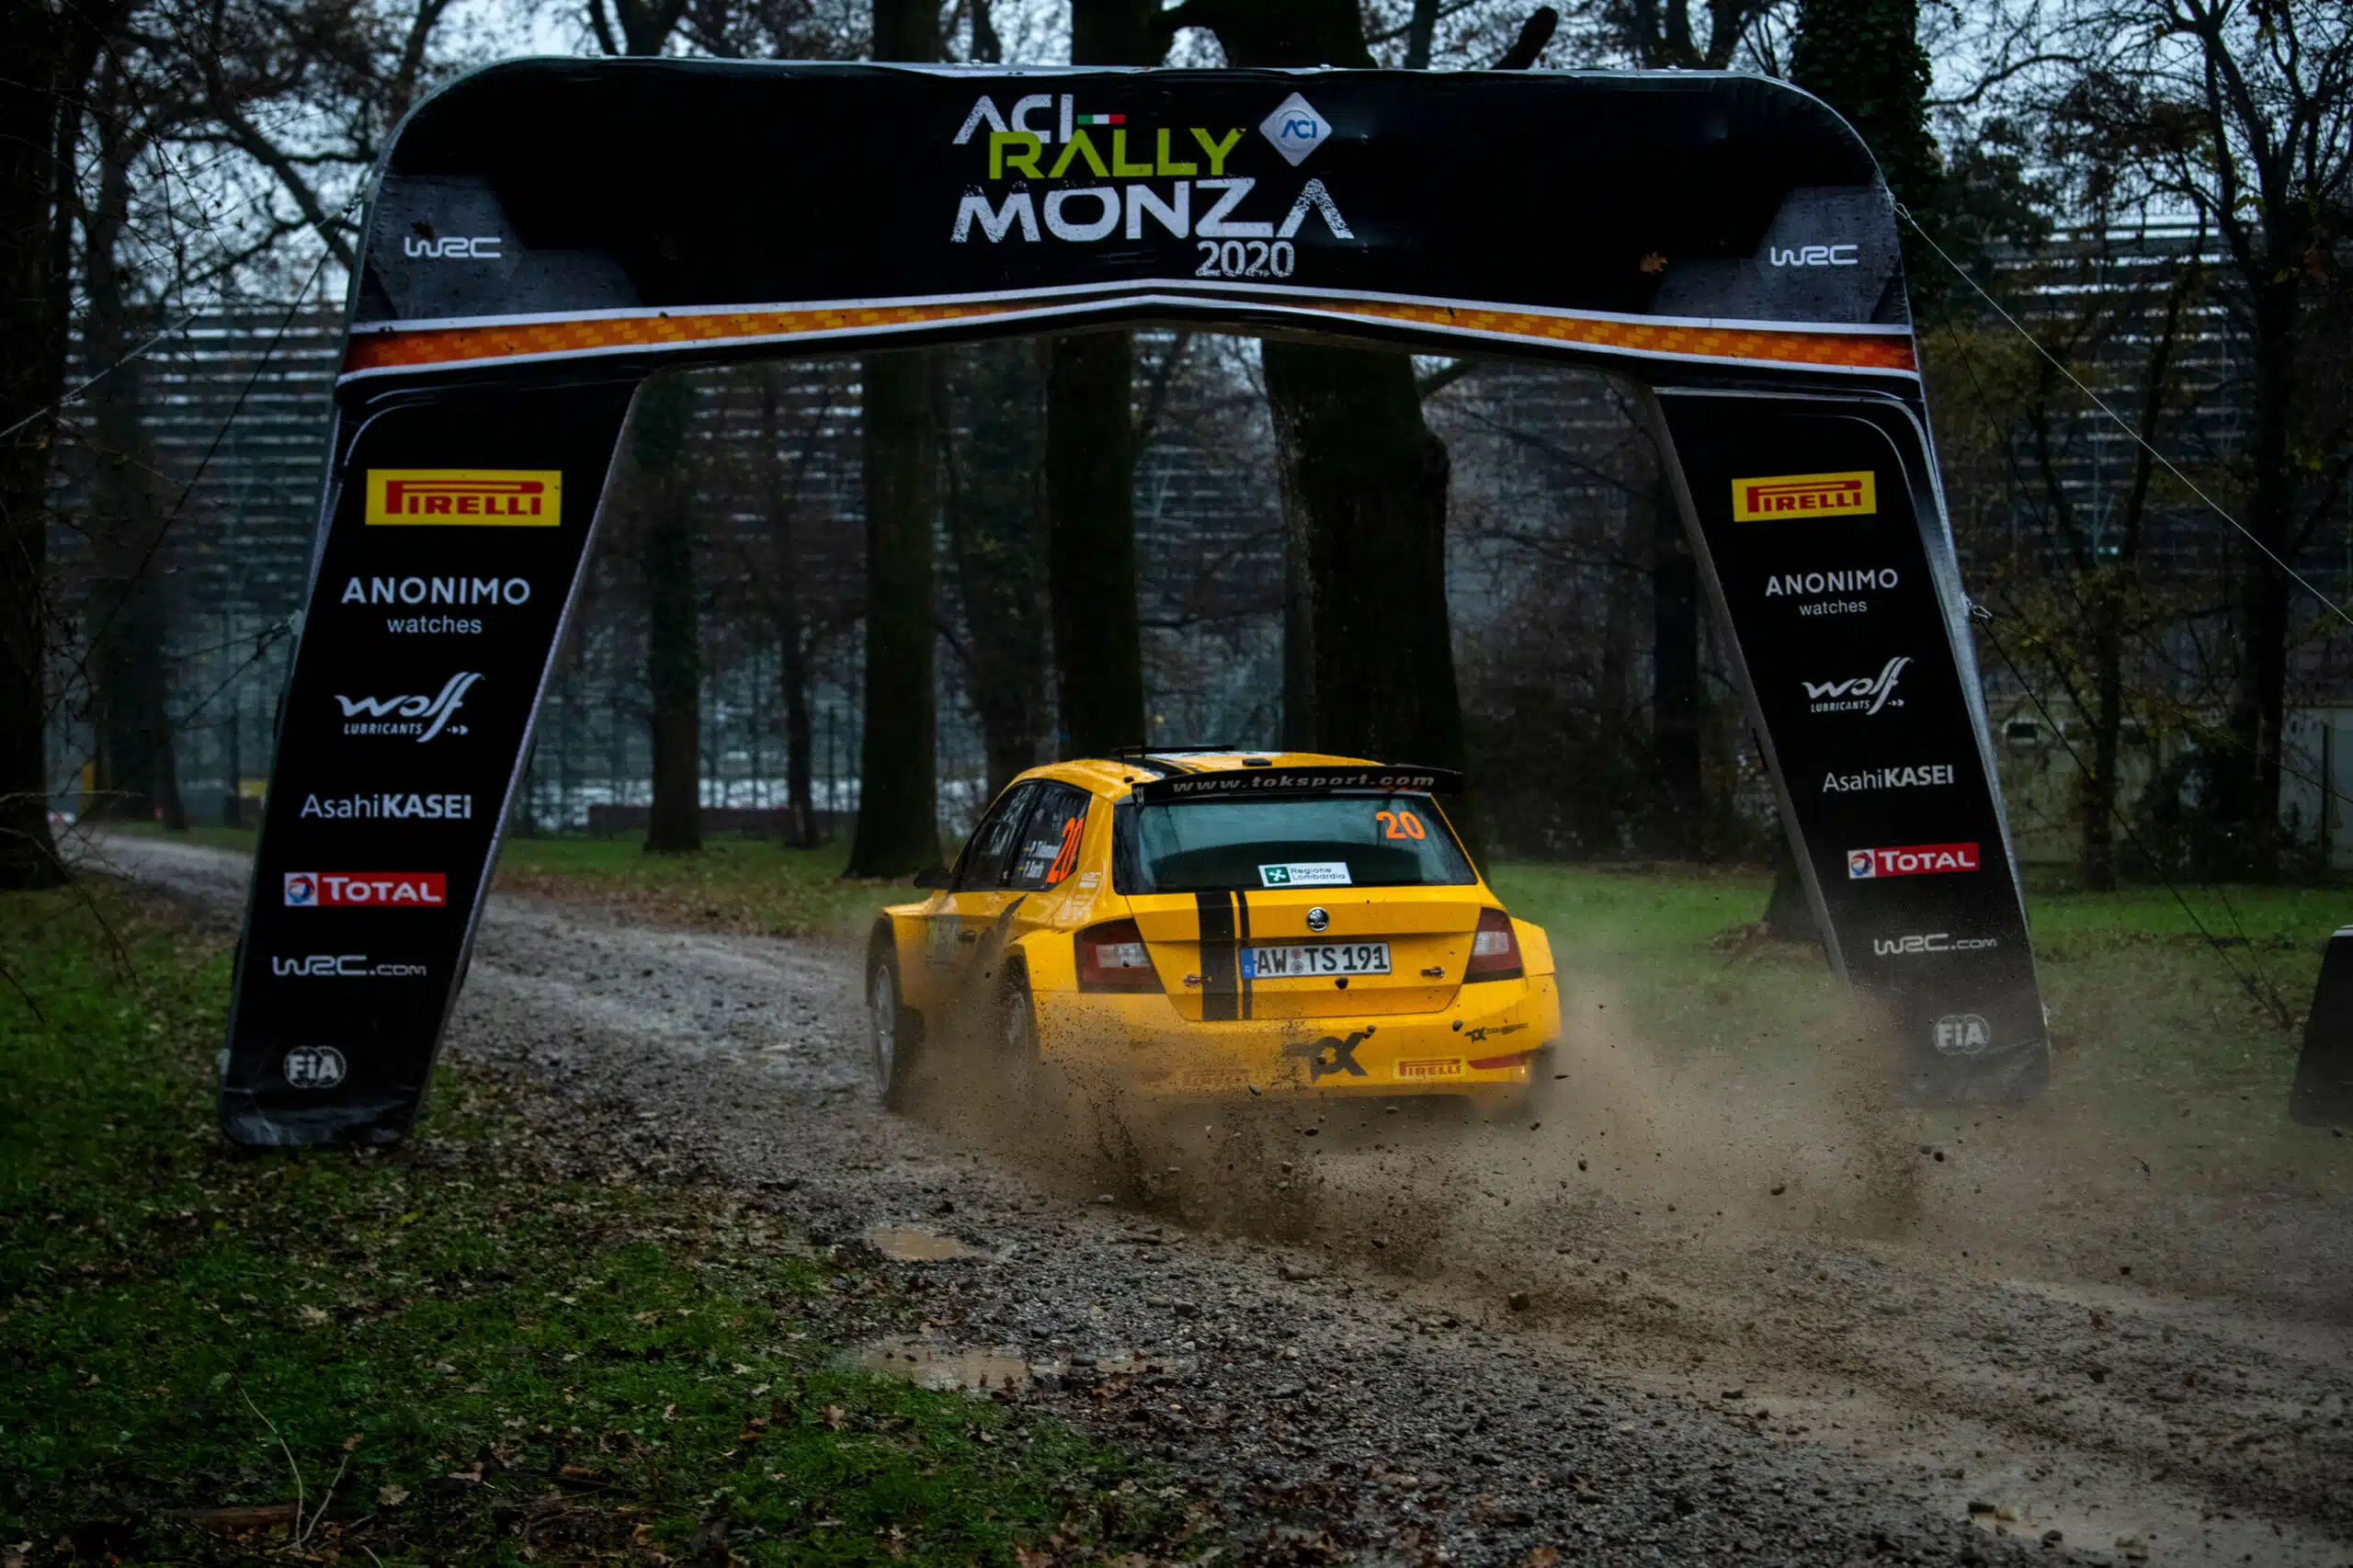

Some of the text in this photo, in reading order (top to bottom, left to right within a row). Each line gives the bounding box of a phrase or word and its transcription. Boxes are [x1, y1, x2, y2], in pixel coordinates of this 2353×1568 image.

[952, 94, 1074, 144] ACI
[1281, 119, 1317, 139] ACI
[989, 128, 1246, 179] RALLY
[950, 177, 1355, 243] MONZA
[404, 236, 502, 257] WRC
[1195, 240, 1295, 277] 2020
[1770, 244, 1859, 267] WRC
[385, 480, 544, 516] PIRELLI
[1746, 480, 1862, 514] PIRELLI
[341, 576, 530, 605] ANONIMO
[1765, 568, 1899, 597] ANONIMO
[1799, 599, 1868, 616] watches
[386, 615, 483, 634] watches
[1811, 699, 1871, 713] LUBRICANTS
[344, 723, 423, 735] LUBRICANTS
[1173, 774, 1434, 793] www.toksport.com
[1376, 811, 1426, 840] 20
[1045, 816, 1086, 883] 20
[1878, 850, 1976, 872] TOTAL
[1290, 867, 1332, 875] Regione
[1292, 872, 1346, 881] Lombardia
[323, 877, 442, 902] TOTAL
[1256, 948, 1288, 974] AW
[1399, 1058, 1461, 1076] PIRELLI
